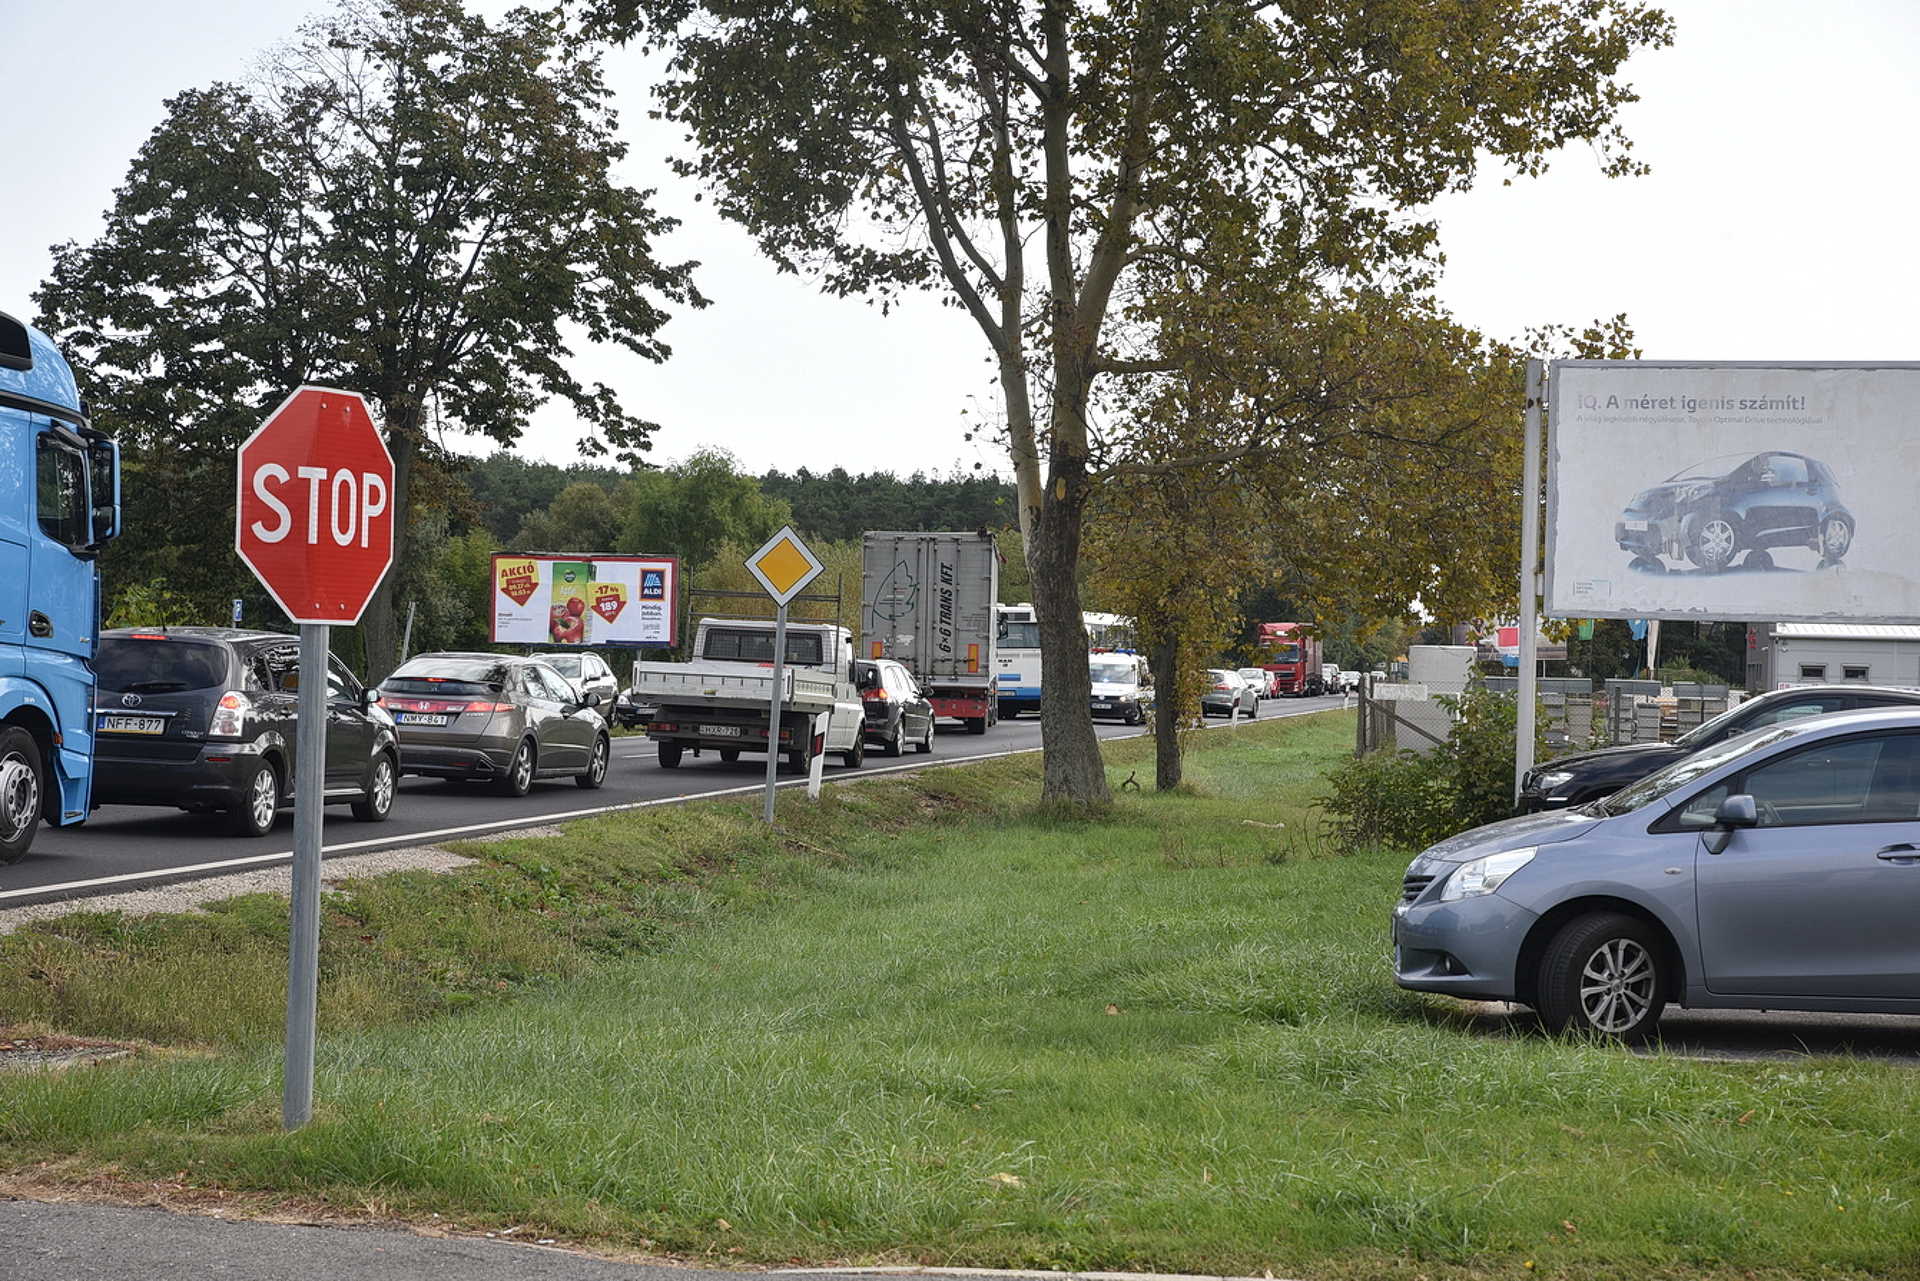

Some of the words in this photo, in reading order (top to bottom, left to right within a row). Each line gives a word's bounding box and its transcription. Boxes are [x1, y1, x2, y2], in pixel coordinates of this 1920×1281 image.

[1606, 395, 1619, 409] A
[1624, 393, 1677, 410] méret
[1682, 395, 1735, 413] igenis
[1739, 394, 1806, 411] számít!
[251, 463, 387, 548] STOP
[501, 561, 535, 578] AKCIÓ
[939, 587, 953, 626] TRANS
[106, 718, 161, 730] NFF-877
